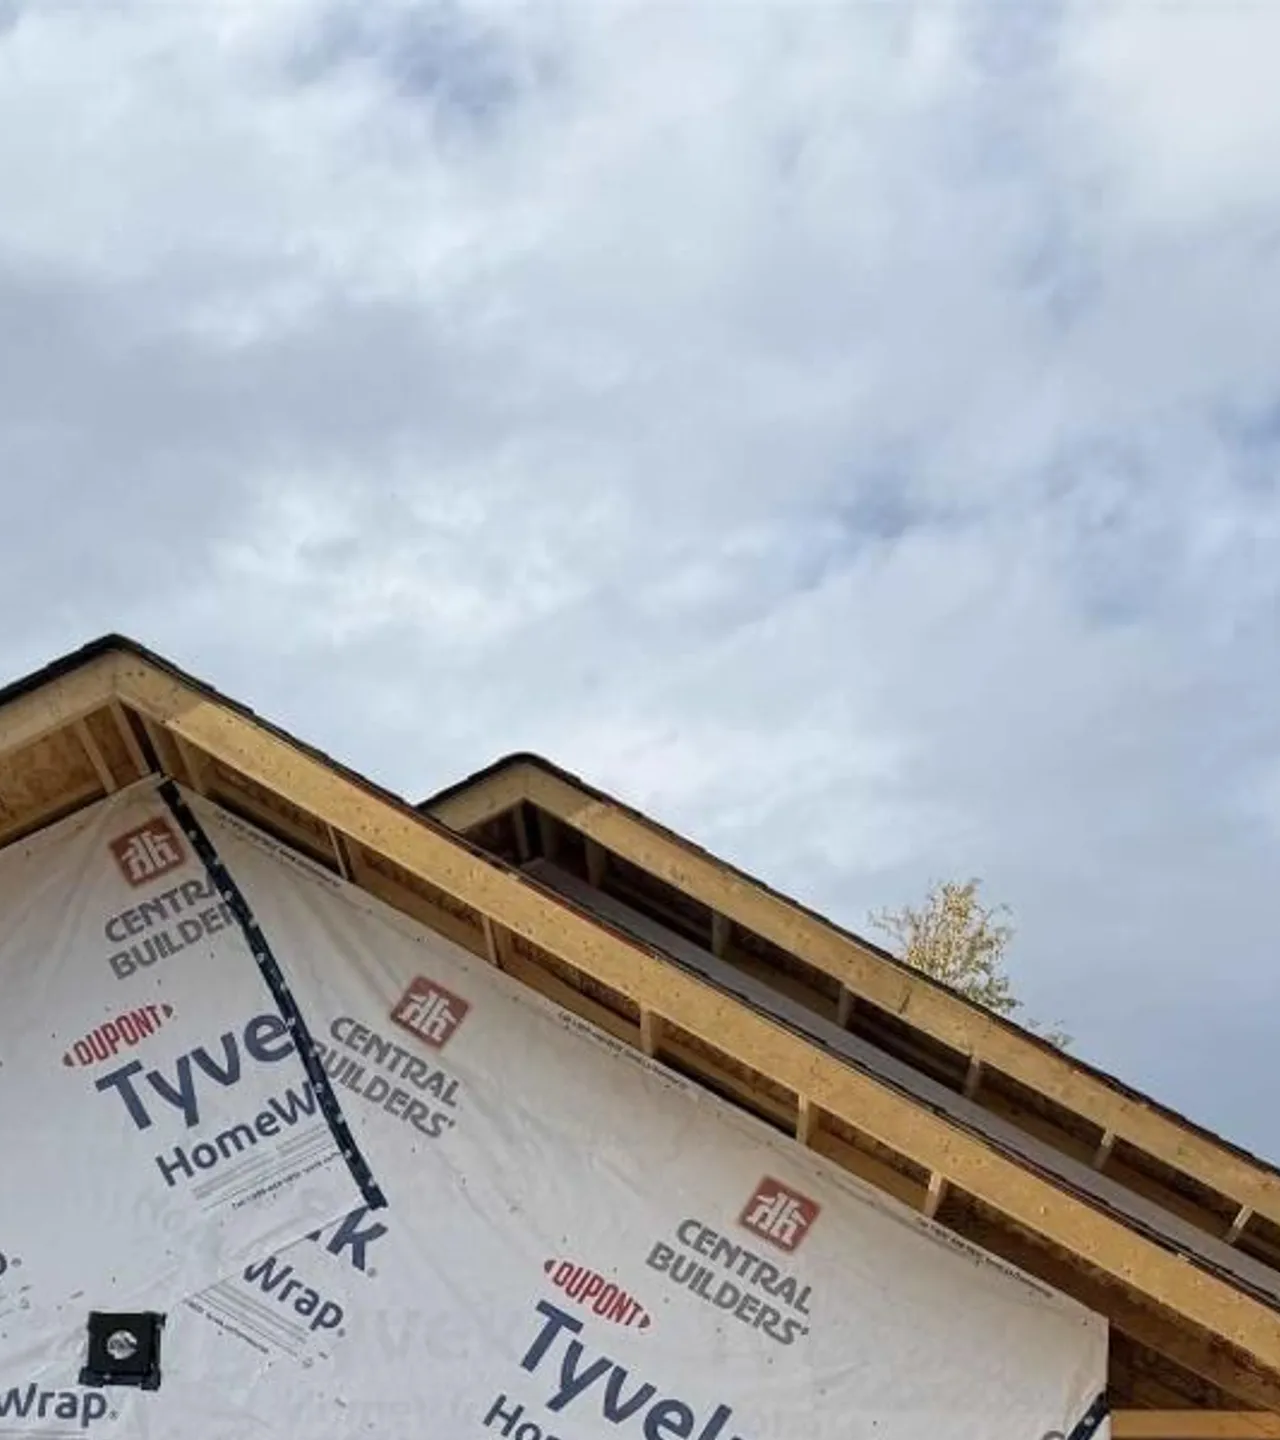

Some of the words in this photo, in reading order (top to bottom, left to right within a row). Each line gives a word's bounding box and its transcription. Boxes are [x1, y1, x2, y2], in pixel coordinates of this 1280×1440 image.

[104, 874, 218, 943] CENTR
[108, 901, 235, 981] BUILDE
[75, 1006, 163, 1066] DUPONT
[95, 1012, 295, 1130] Tyve
[329, 1016, 461, 1108] CENTRAL
[155, 1081, 318, 1187] HomeW
[242, 1254, 345, 1332] Wrap
[553, 1260, 644, 1330] DUPONT
[676, 1218, 813, 1314] CENTRAL
